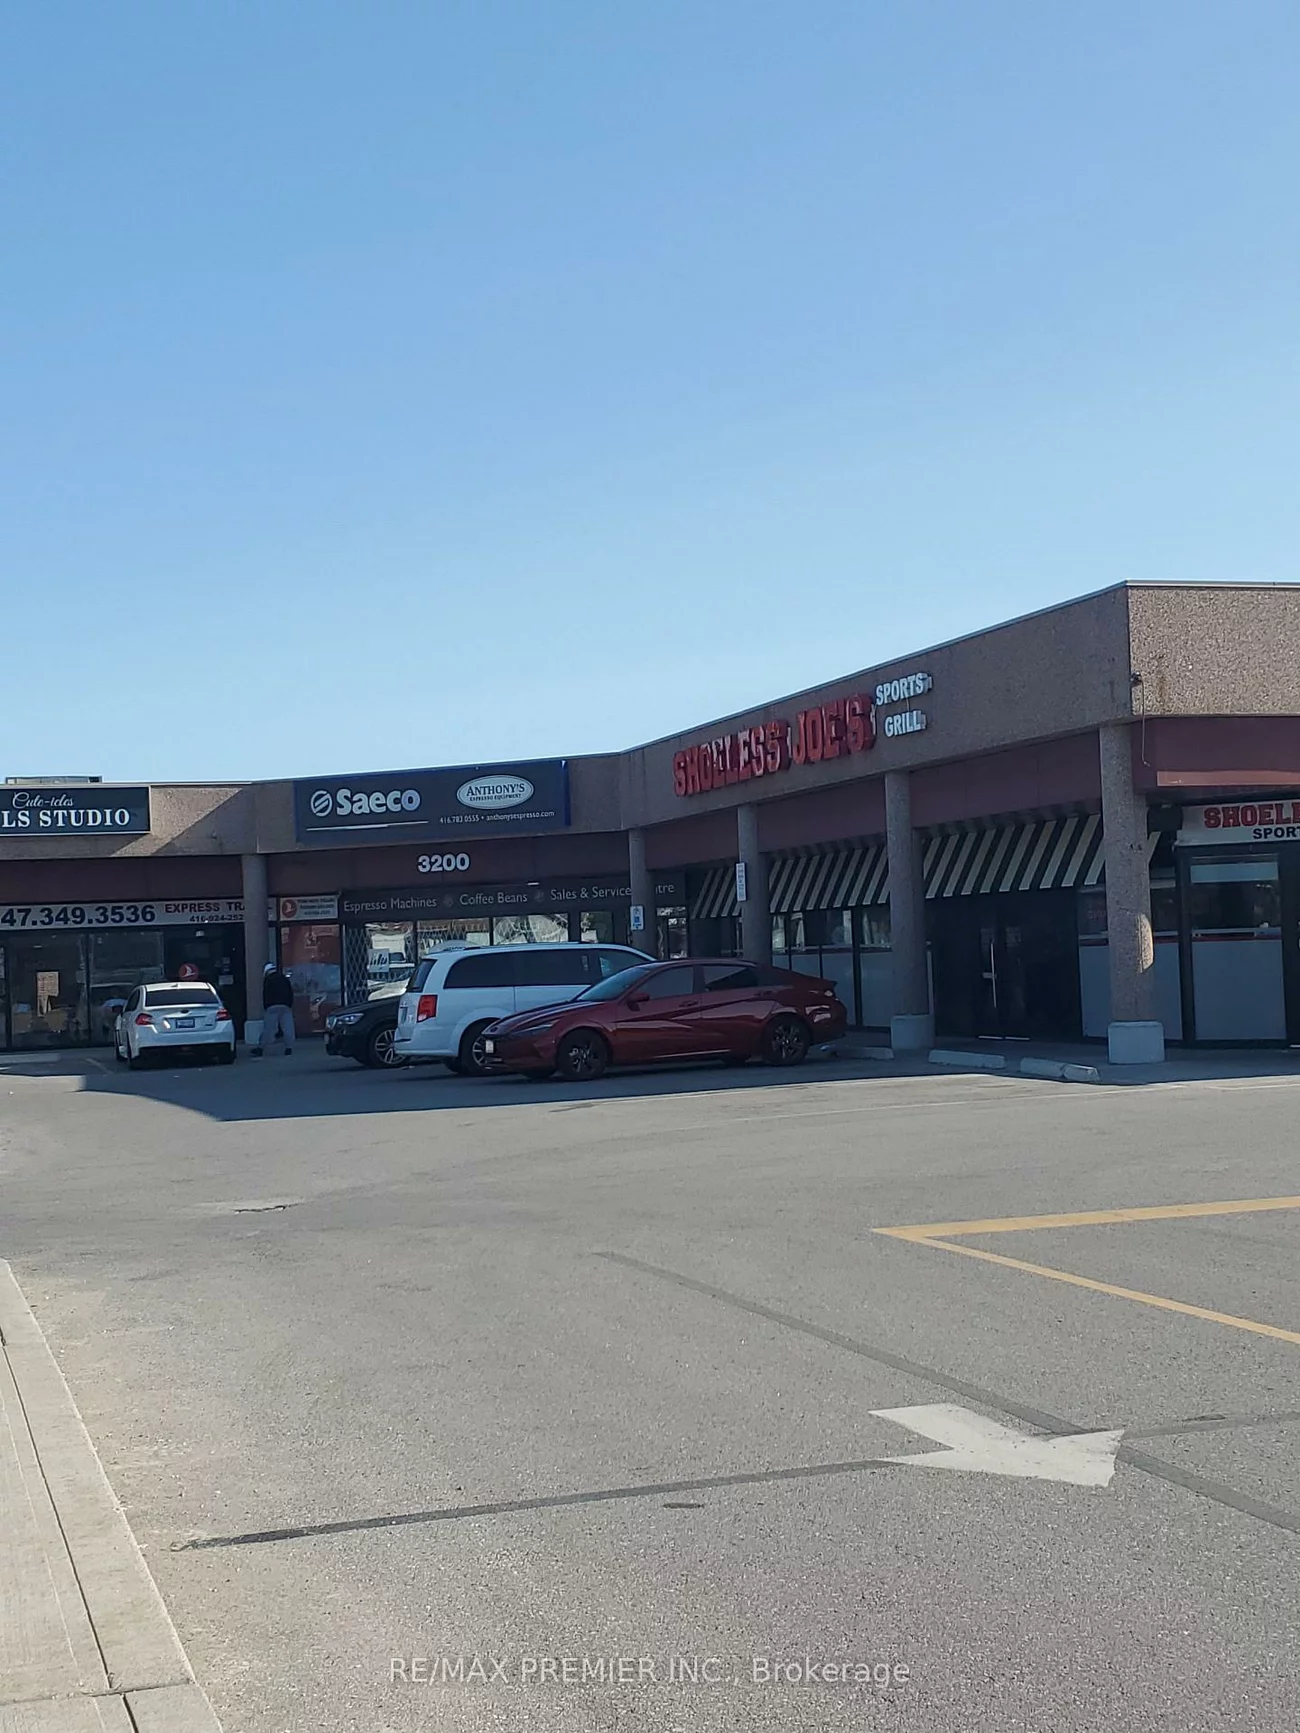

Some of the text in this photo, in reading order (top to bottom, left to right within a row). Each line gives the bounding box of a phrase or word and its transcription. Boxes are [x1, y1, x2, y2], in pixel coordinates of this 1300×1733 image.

[876, 673, 926, 705] SPORTS
[885, 710, 923, 737] GRILL
[673, 693, 873, 796] SHOELESS JOE'S
[336, 788, 421, 816] Saeco
[466, 783, 526, 797] ANTHONY'S
[1, 808, 130, 828] LS STUDIO
[417, 853, 470, 873] 3200
[165, 901, 245, 914] EXPRESS TR
[343, 901, 388, 914] Espresso
[390, 897, 437, 910] Machines
[459, 892, 494, 905] Coffee
[497, 891, 528, 903] Beans
[550, 889, 577, 900] Sales
[580, 887, 589, 898] &
[592, 886, 632, 898] Service
